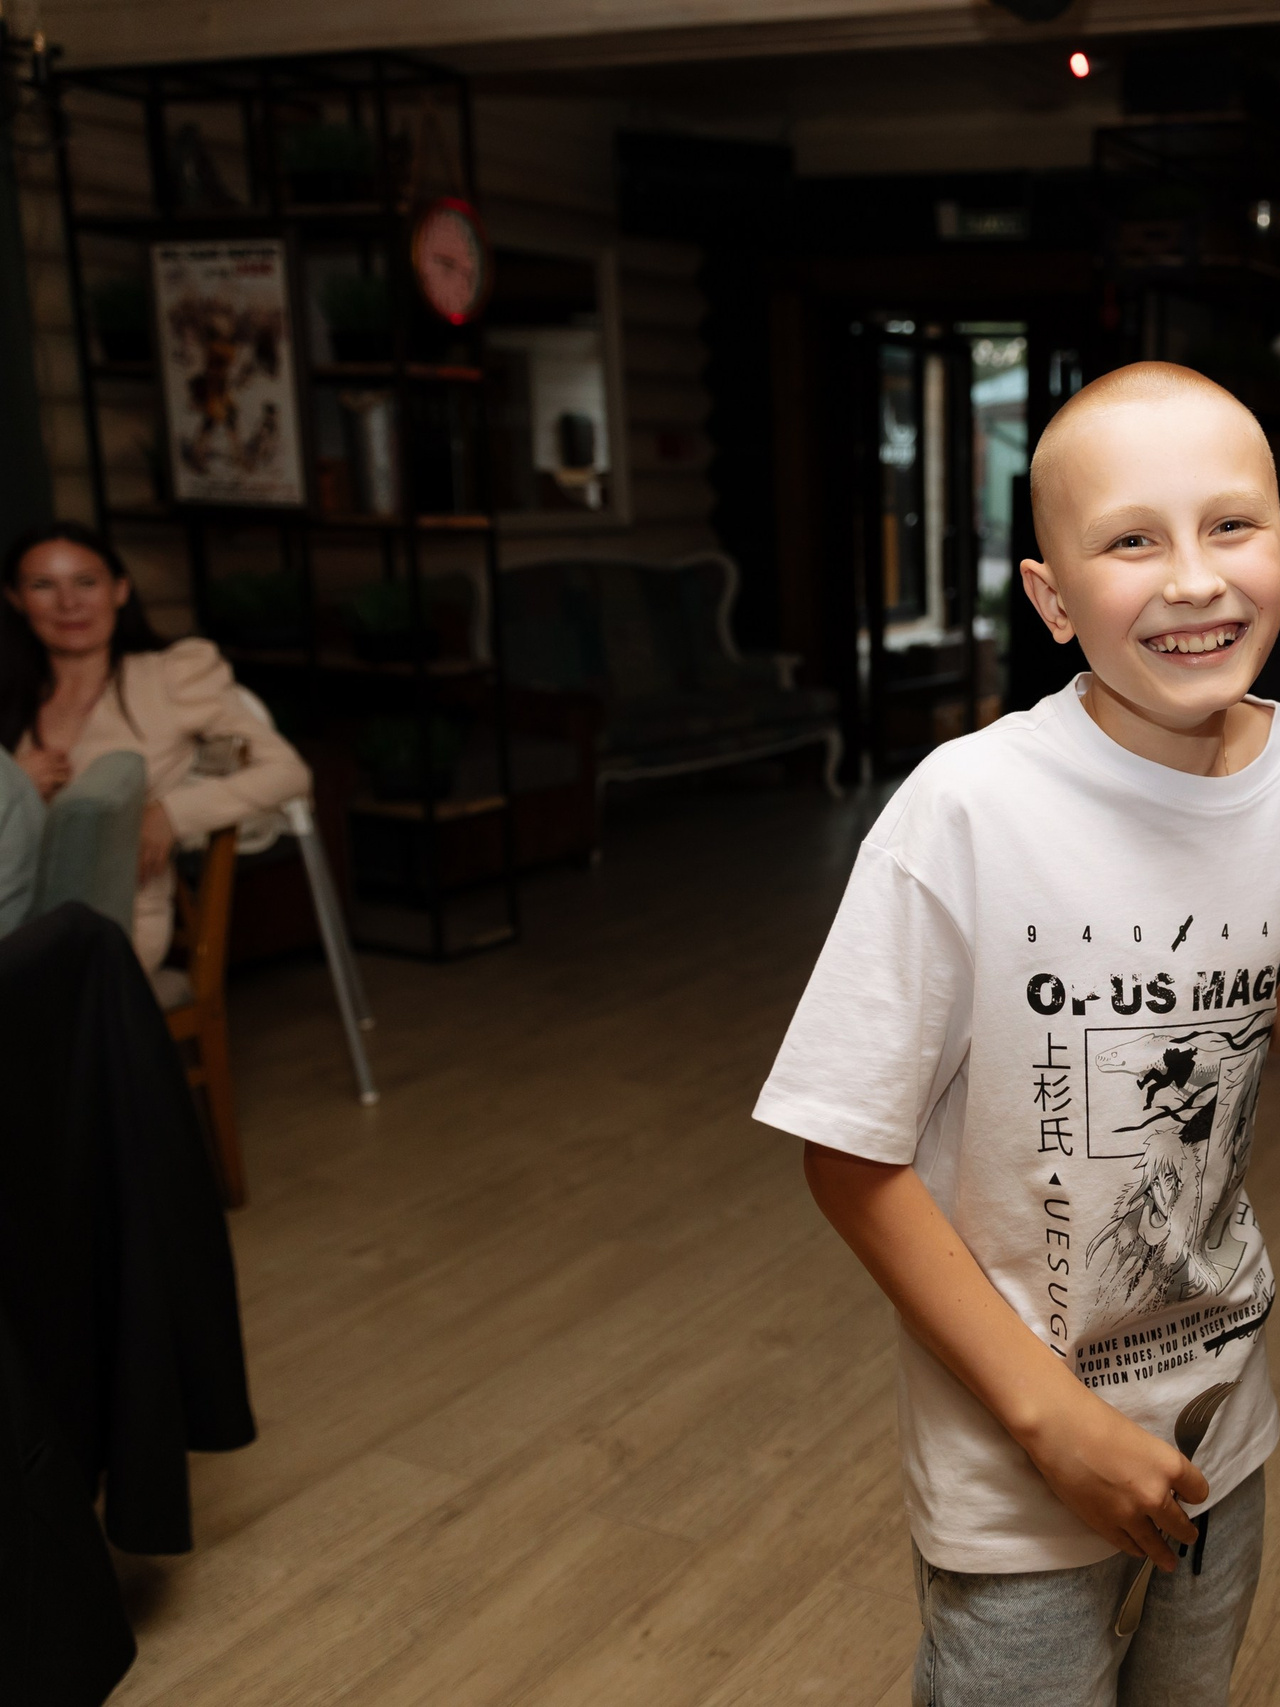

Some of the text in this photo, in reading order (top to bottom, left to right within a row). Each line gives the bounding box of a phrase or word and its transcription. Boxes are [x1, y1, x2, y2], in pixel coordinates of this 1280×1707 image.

[1027, 925, 1037, 943] 9
[1082, 925, 1092, 943] 4
[1032, 1032, 1073, 1157] 上杉氏
[1044, 1198, 1070, 1358] UESUGI
[1080, 1357, 1110, 1373] YOUR
[1116, 1348, 1156, 1366] SHOES.
[1160, 1339, 1178, 1355] YOU
[1182, 1330, 1197, 1347] CAN
[1200, 1317, 1225, 1338] STEER
[1089, 1338, 1118, 1355] HAVE
[1124, 1327, 1162, 1348] BRAINS
[1166, 1322, 1177, 1336] IN
[1180, 1311, 1200, 1330] YOUR
[1081, 1349, 1198, 1388] ECTION YOU CHOOSE.
